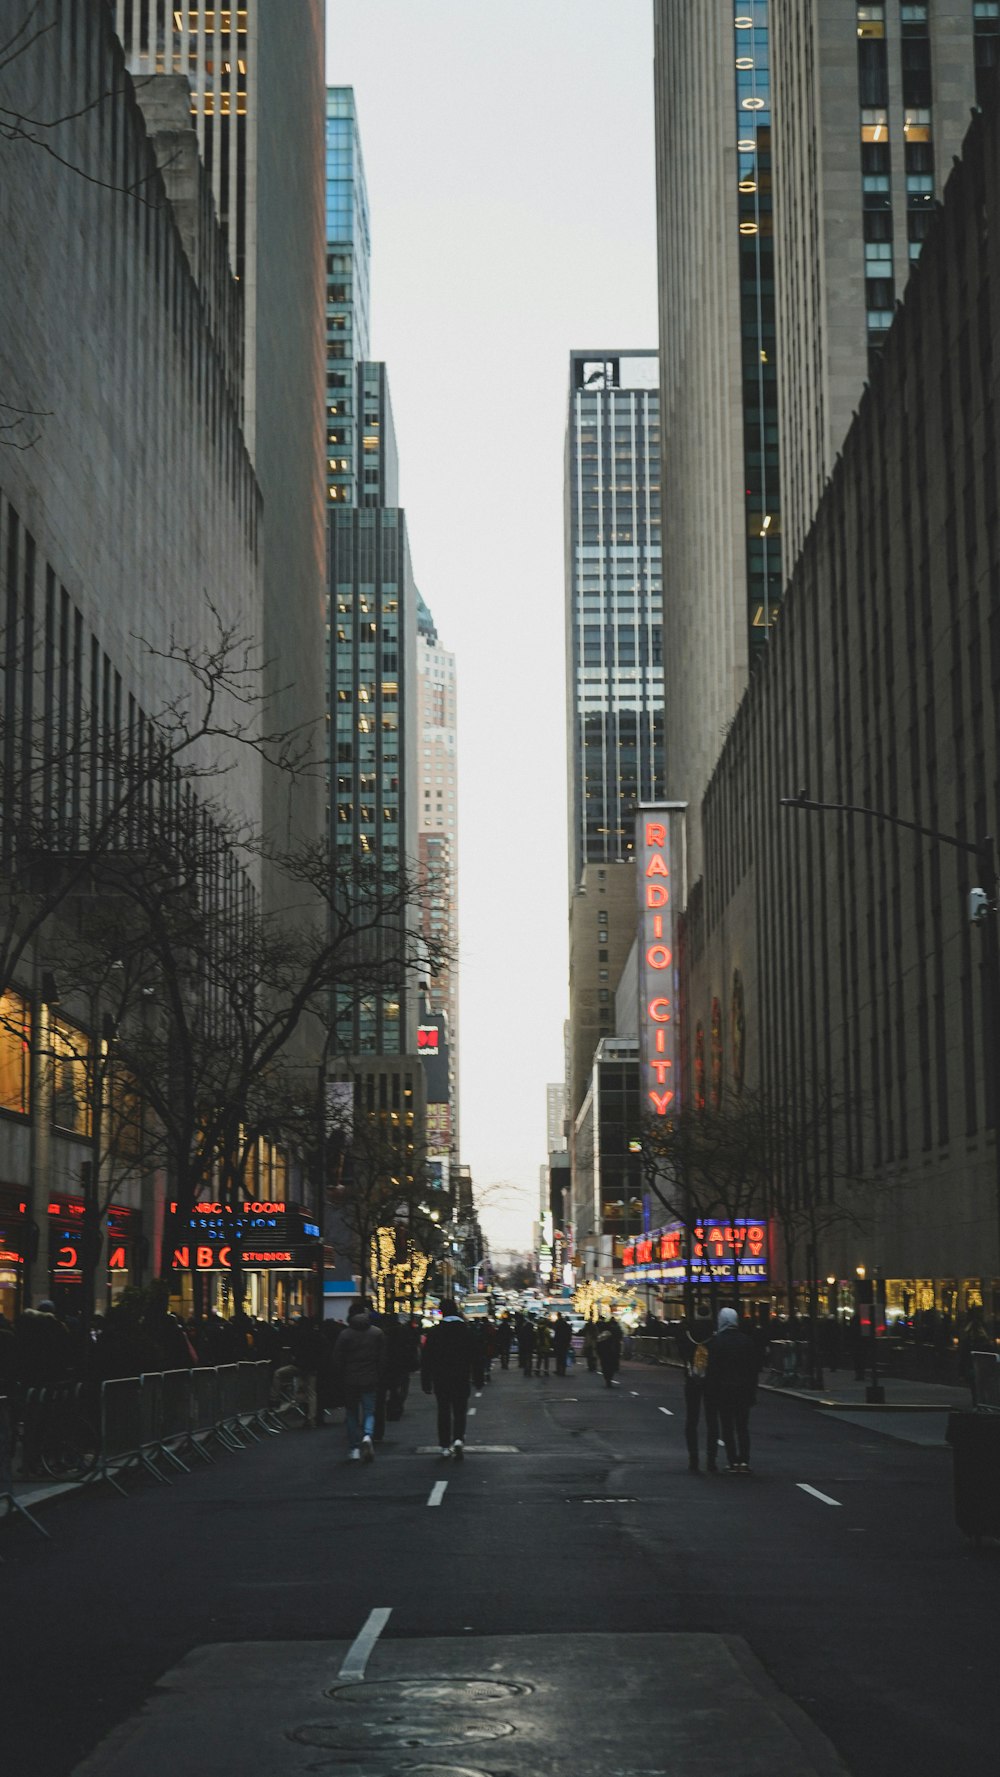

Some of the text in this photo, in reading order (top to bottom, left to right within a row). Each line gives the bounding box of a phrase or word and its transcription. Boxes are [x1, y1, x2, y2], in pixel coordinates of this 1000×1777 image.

[645, 823, 673, 1115] RADIO CITY
[171, 1246, 292, 1268] NBC STUDIOS
[694, 1242, 763, 1257] CITY
